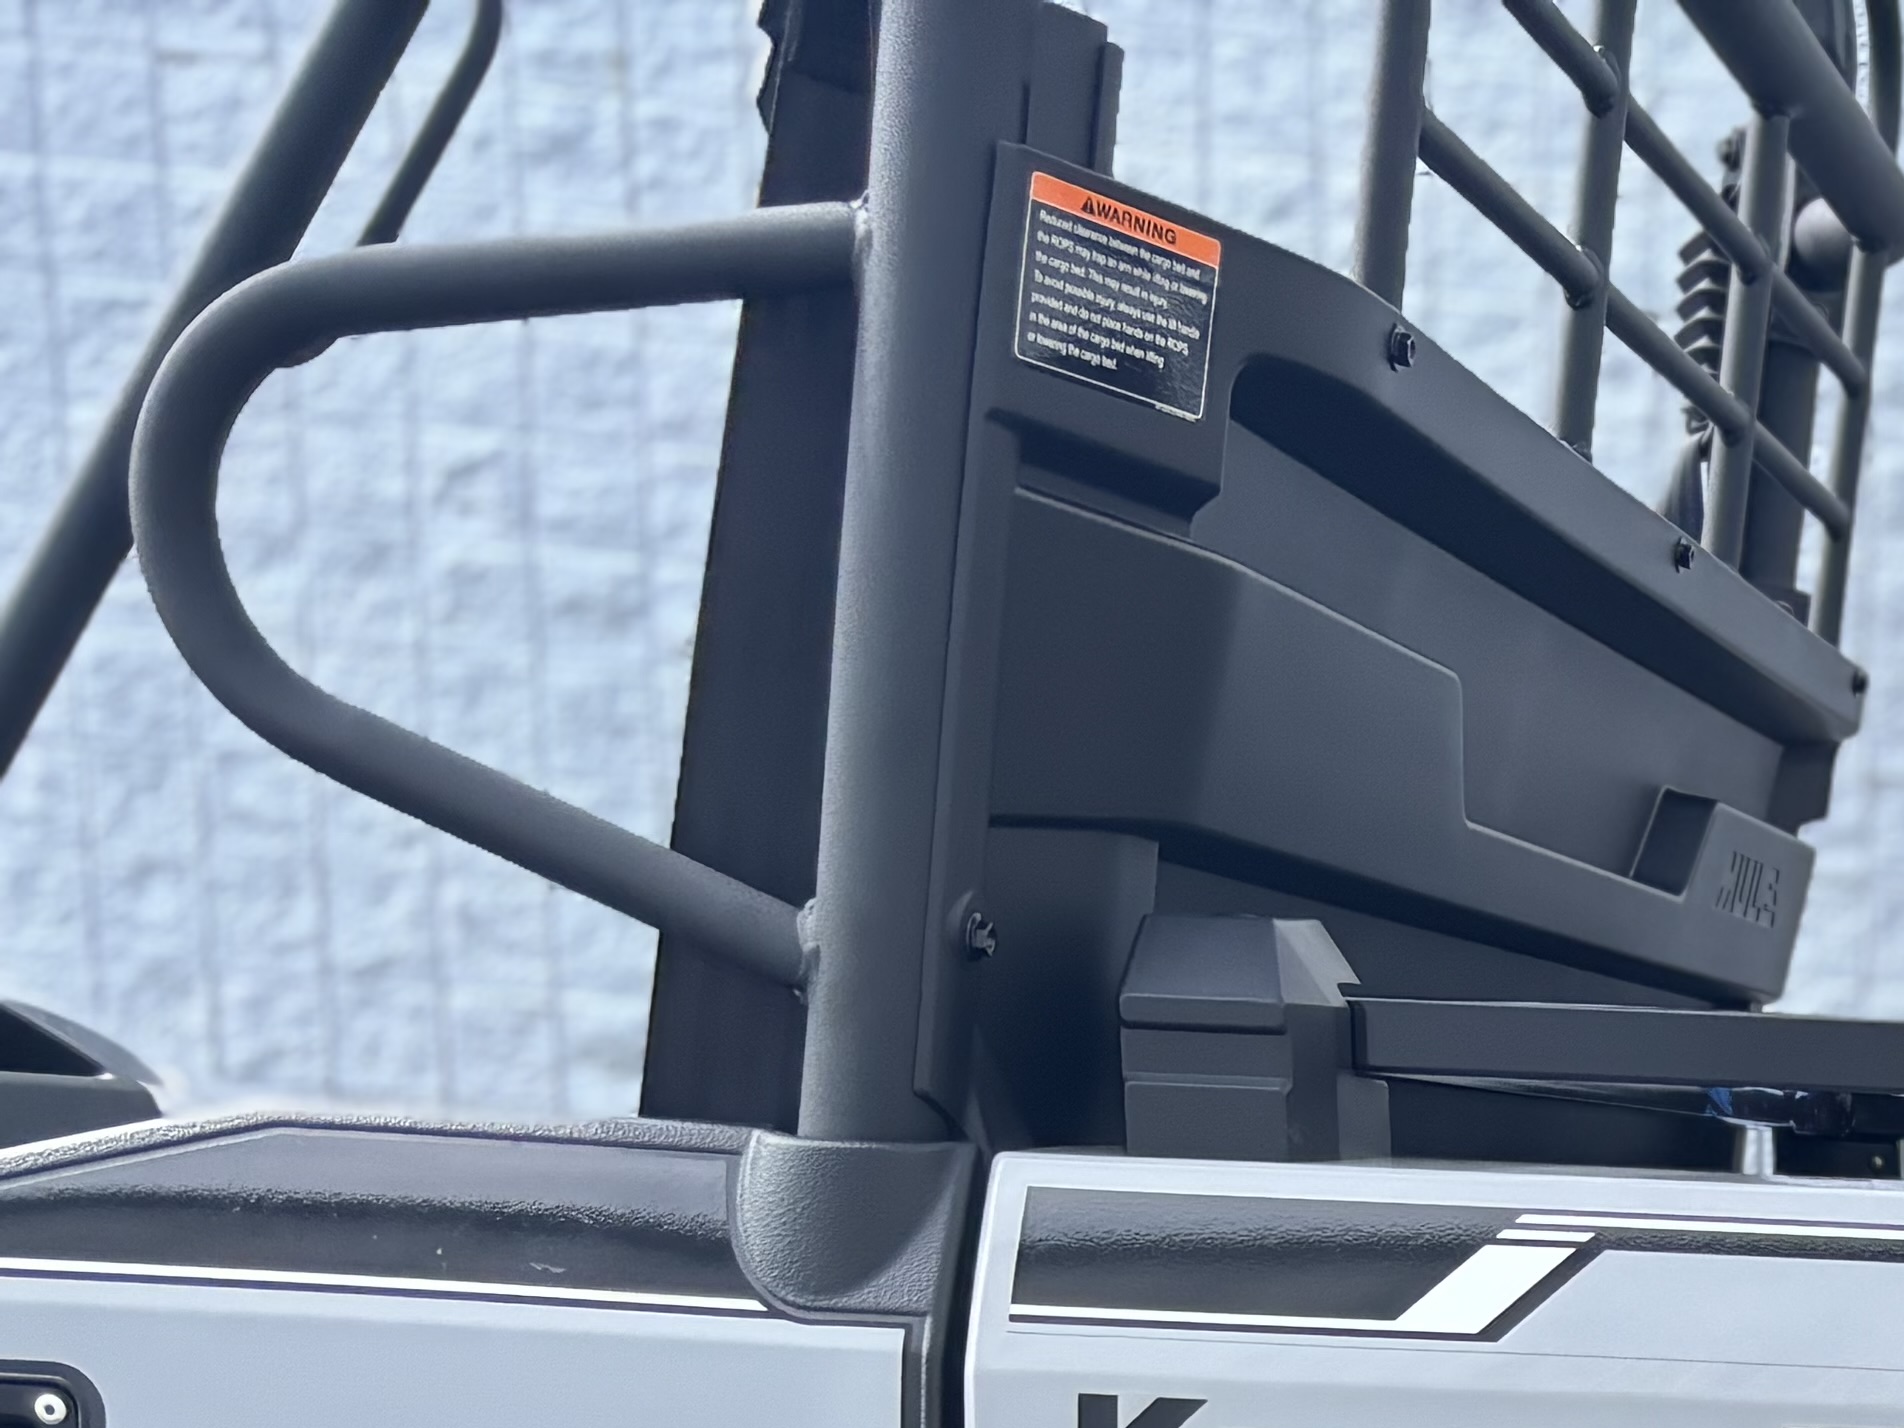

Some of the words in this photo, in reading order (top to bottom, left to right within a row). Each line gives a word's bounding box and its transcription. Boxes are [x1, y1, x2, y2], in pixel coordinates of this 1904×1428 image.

[1096, 200, 1177, 245] WARNING
[1036, 229, 1050, 245] the
[1035, 250, 1049, 265] the
[1047, 256, 1071, 274] cargo
[1139, 247, 1152, 261] the
[1151, 253, 1172, 271] cargo
[1037, 312, 1051, 327] the
[1076, 326, 1090, 341] the
[1089, 332, 1111, 349] cargo
[1063, 302, 1079, 317] and
[1154, 333, 1167, 348] the
[1155, 313, 1168, 328] the
[1067, 343, 1080, 358] the
[1079, 349, 1101, 366] cargo
